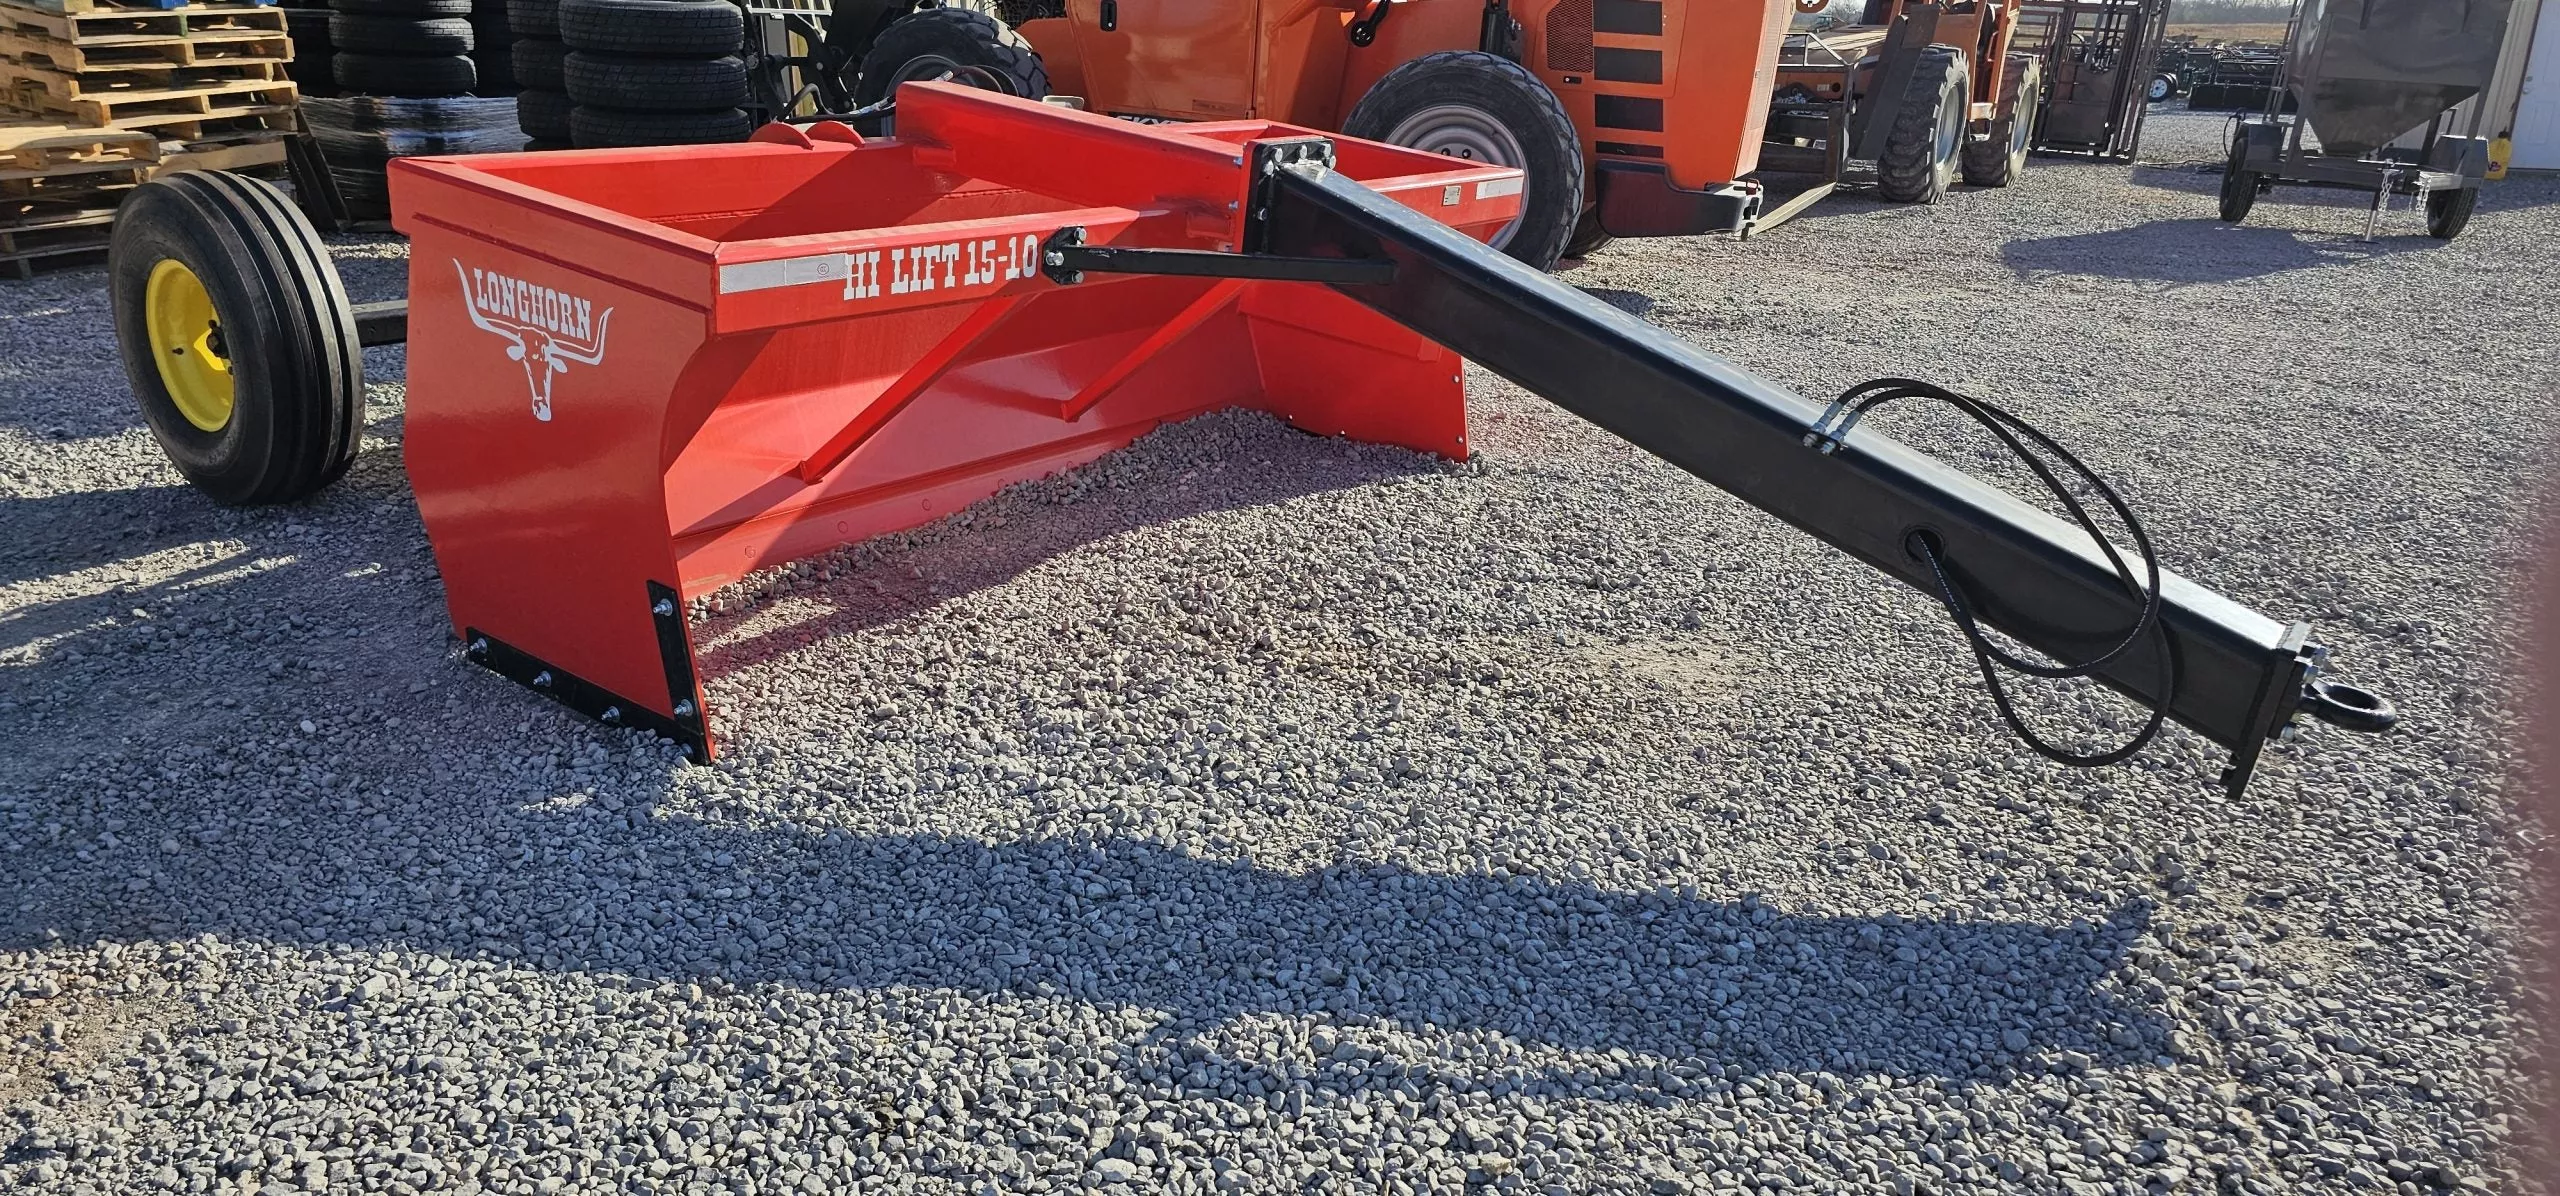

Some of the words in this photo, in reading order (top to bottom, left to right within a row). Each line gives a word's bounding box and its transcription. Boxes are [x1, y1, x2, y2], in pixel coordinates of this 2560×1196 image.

[843, 250, 881, 301] HI
[890, 242, 960, 295] LIFT
[964, 234, 1038, 286] 15-10
[473, 267, 591, 342] LONGHORN
